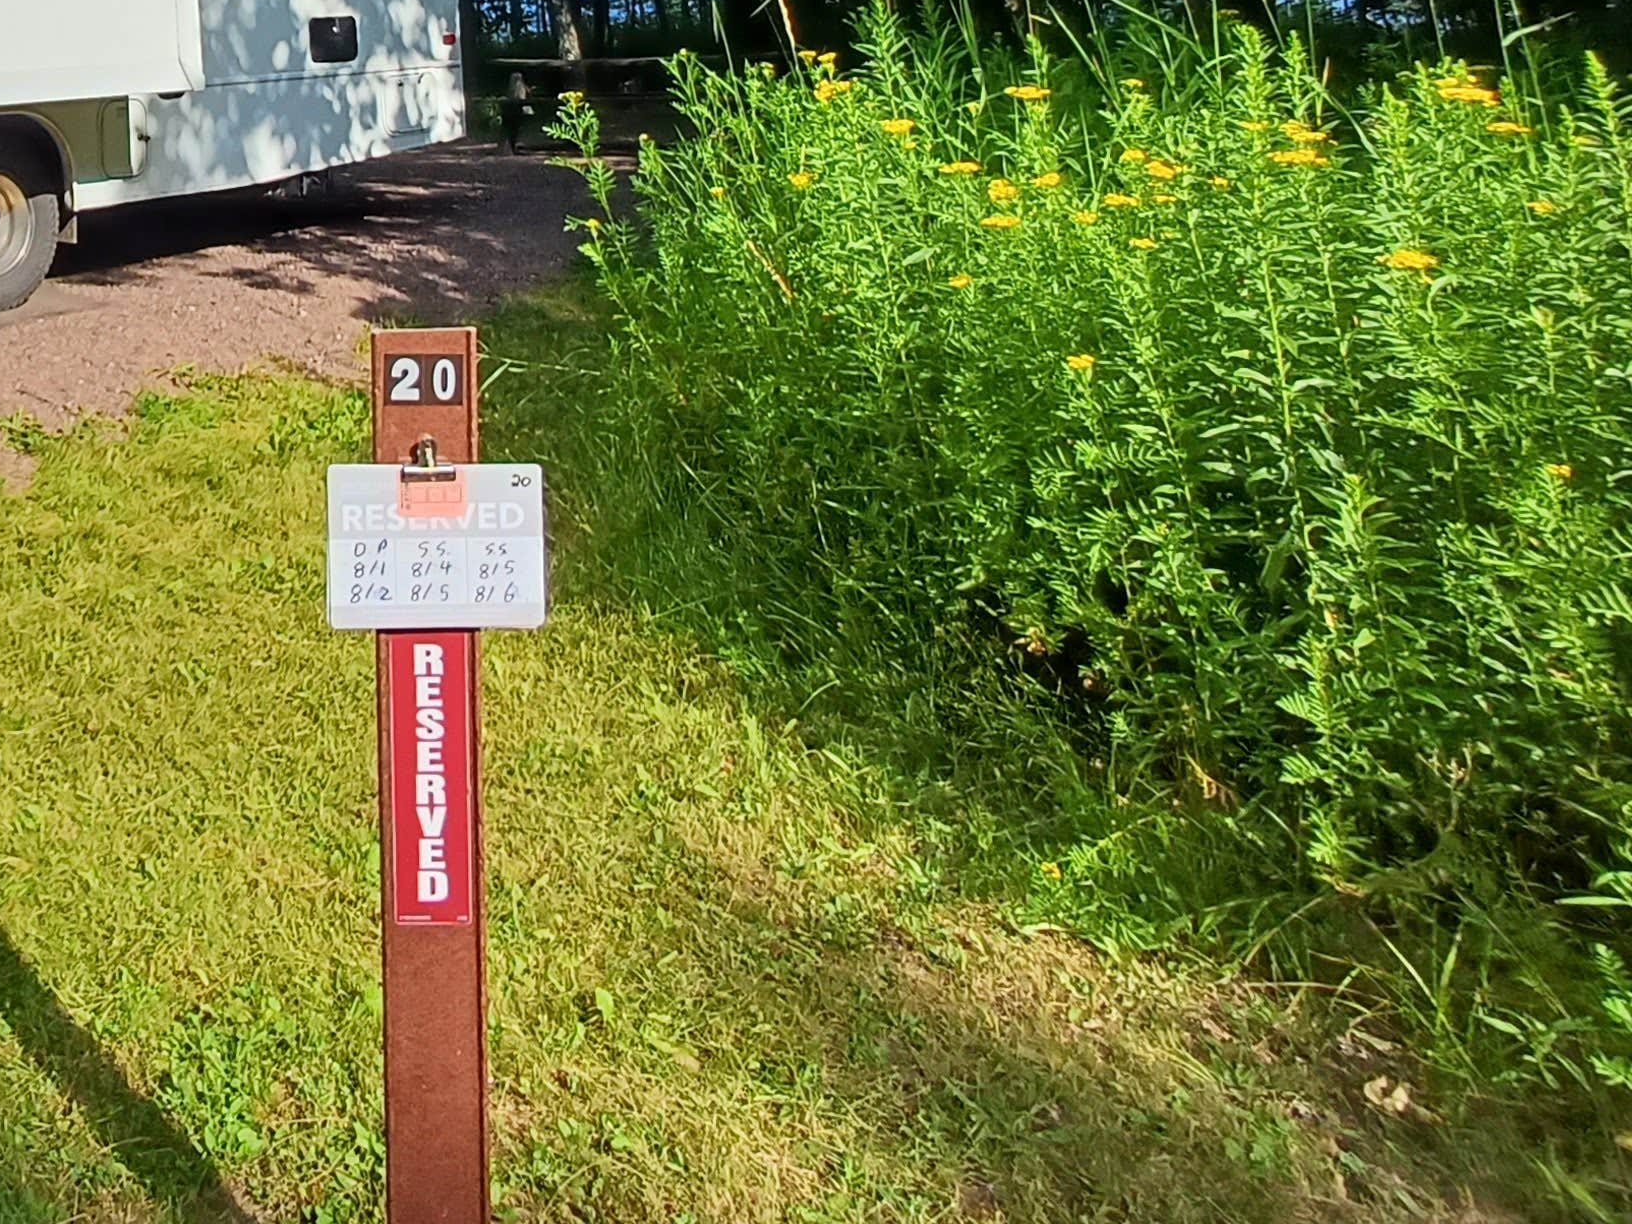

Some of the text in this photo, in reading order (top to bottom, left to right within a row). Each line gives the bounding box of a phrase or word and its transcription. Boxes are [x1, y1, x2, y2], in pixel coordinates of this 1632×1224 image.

[390, 357, 457, 401] 20
[511, 473, 531, 487] 20
[413, 643, 449, 902] RESERVED
